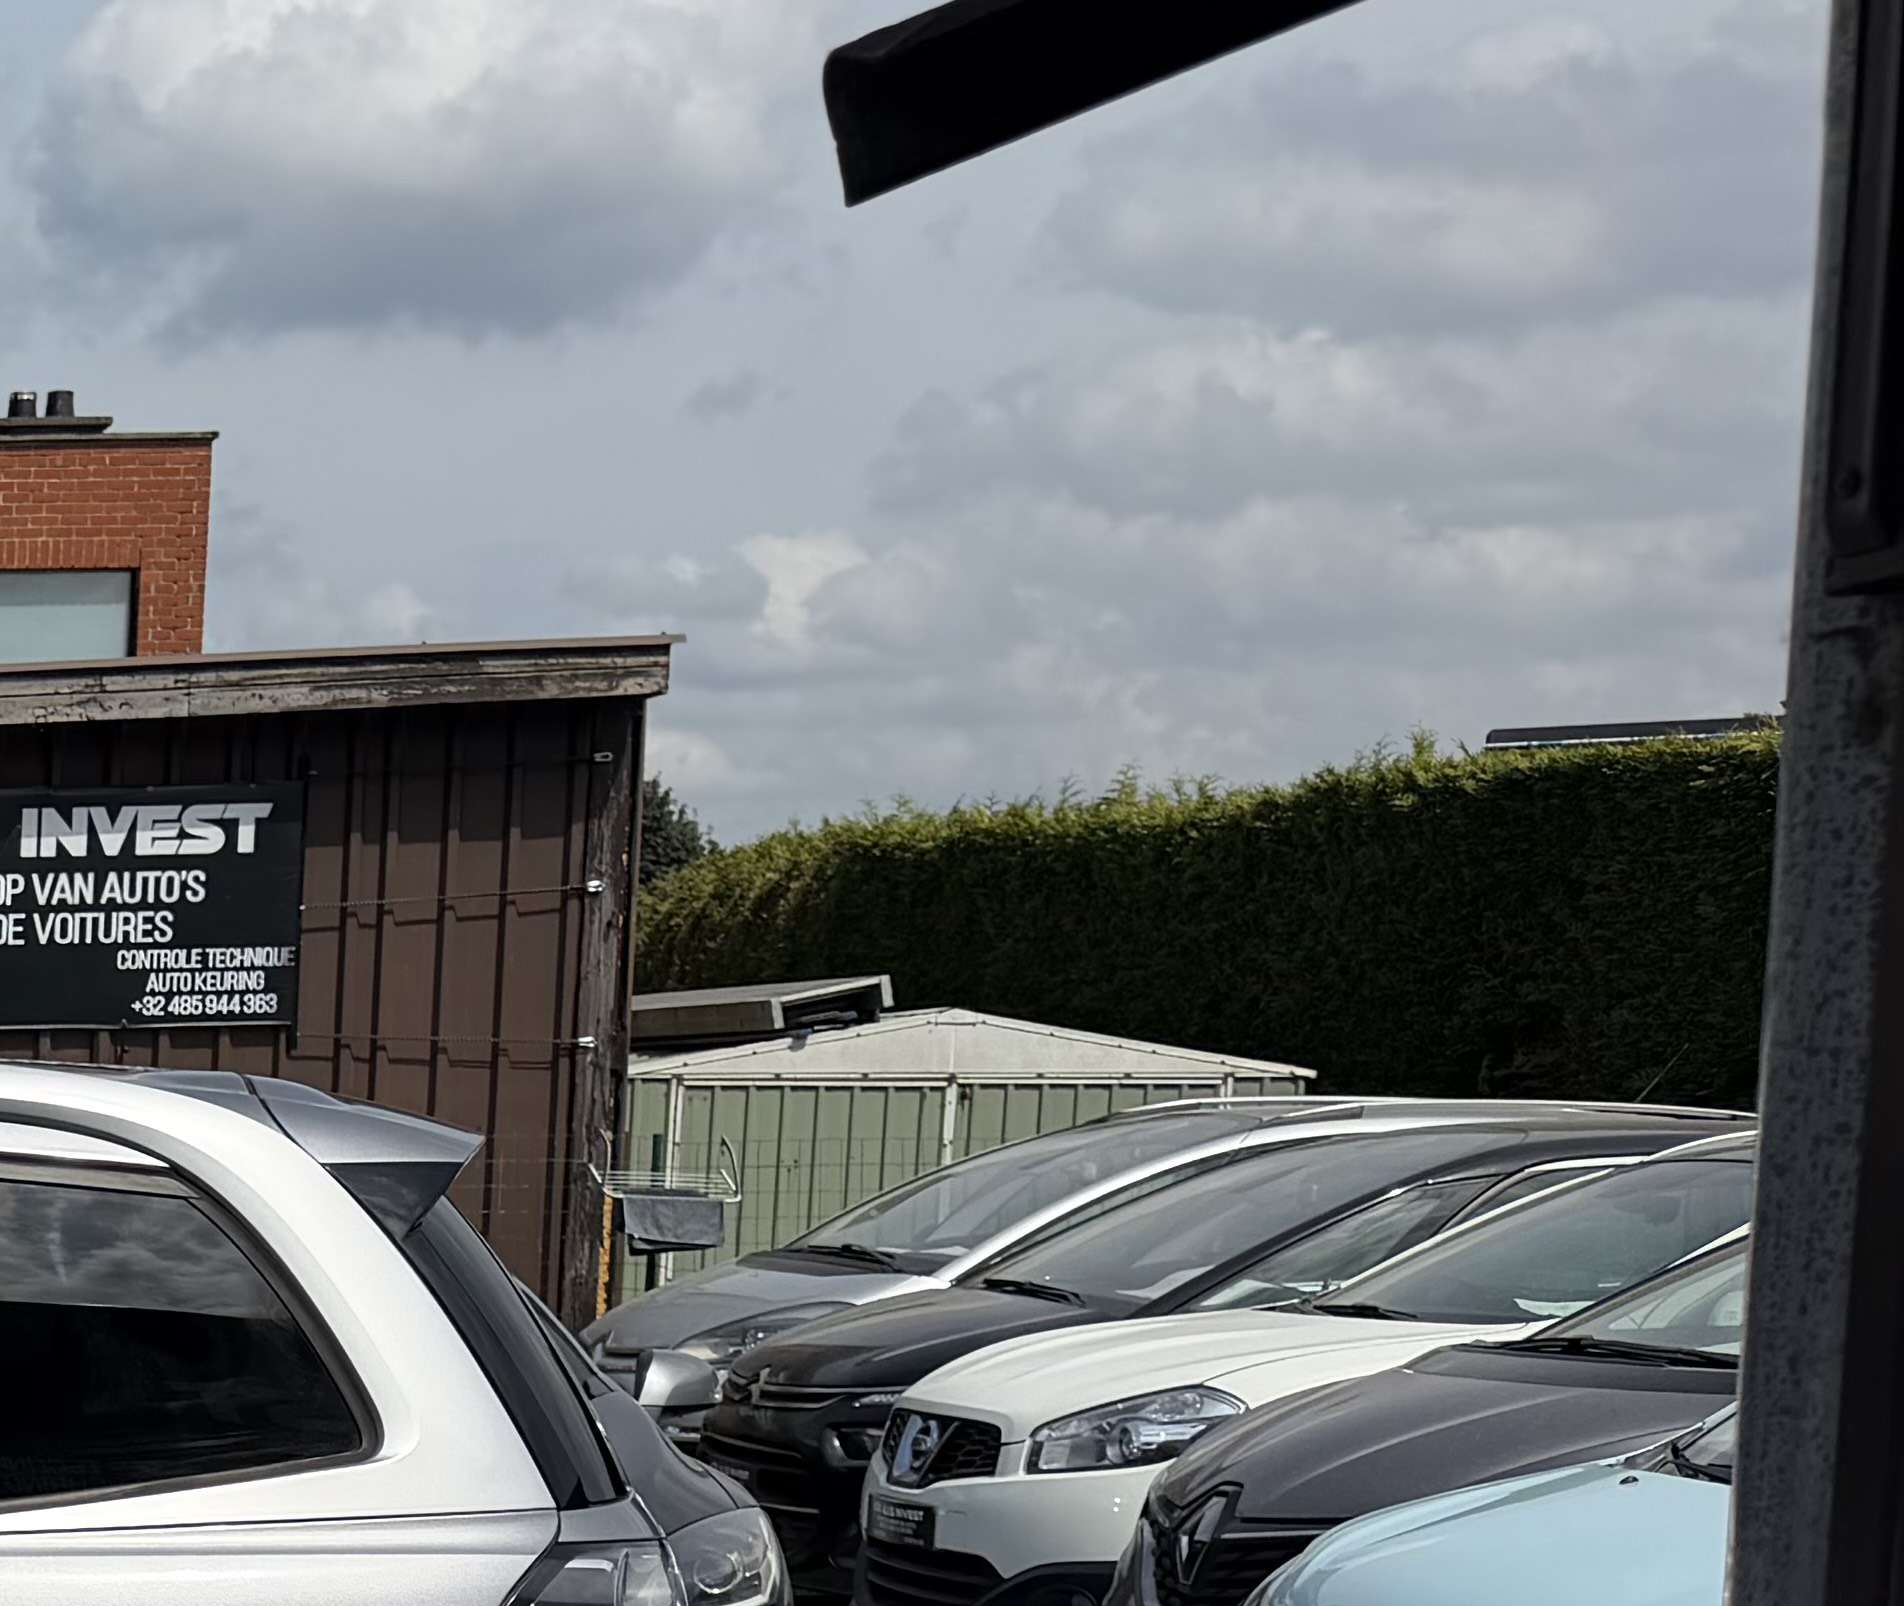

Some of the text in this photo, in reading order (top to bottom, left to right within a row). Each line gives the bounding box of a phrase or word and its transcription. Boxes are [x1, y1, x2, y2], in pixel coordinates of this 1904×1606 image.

[19, 802, 274, 858] INVEST
[32, 872, 94, 906] VAN
[100, 870, 206, 904] AUTO'S
[33, 910, 174, 944] VOITURES
[117, 946, 296, 970] CONTROLE TECHNIQUE
[145, 970, 265, 993] AUTO KEURING
[131, 995, 166, 1016] +32
[167, 994, 203, 1015] 485
[205, 994, 241, 1015] 944
